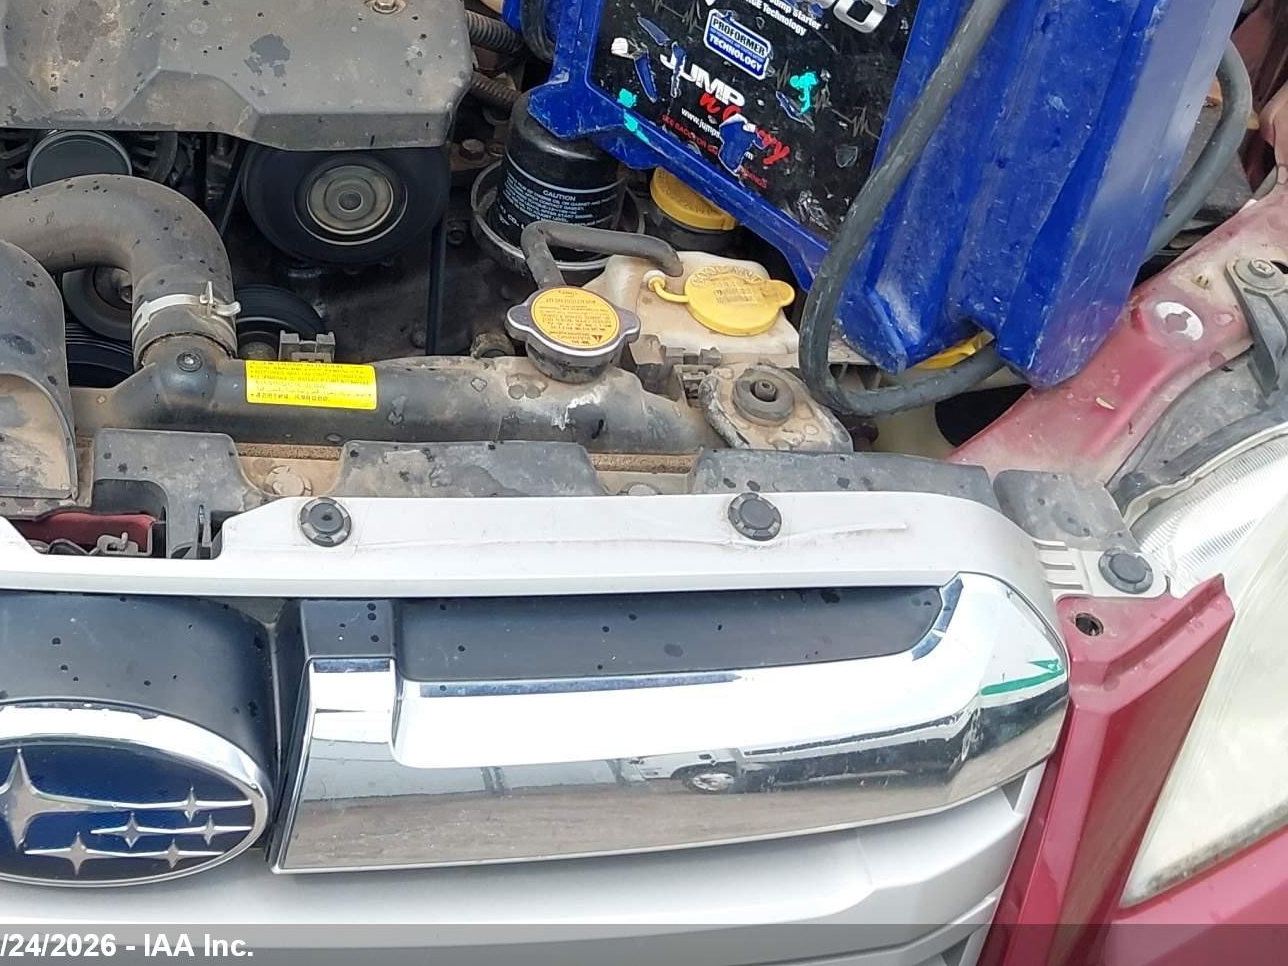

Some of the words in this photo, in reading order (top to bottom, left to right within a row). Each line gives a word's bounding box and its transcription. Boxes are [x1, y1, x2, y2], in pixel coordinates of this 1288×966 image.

[762, 2, 808, 36] Technology
[792, 6, 822, 30] Starter
[709, 34, 762, 72] TECHNOLOGY
[713, 18, 765, 56] PROFORMER
[542, 190, 577, 202] CAUTION
